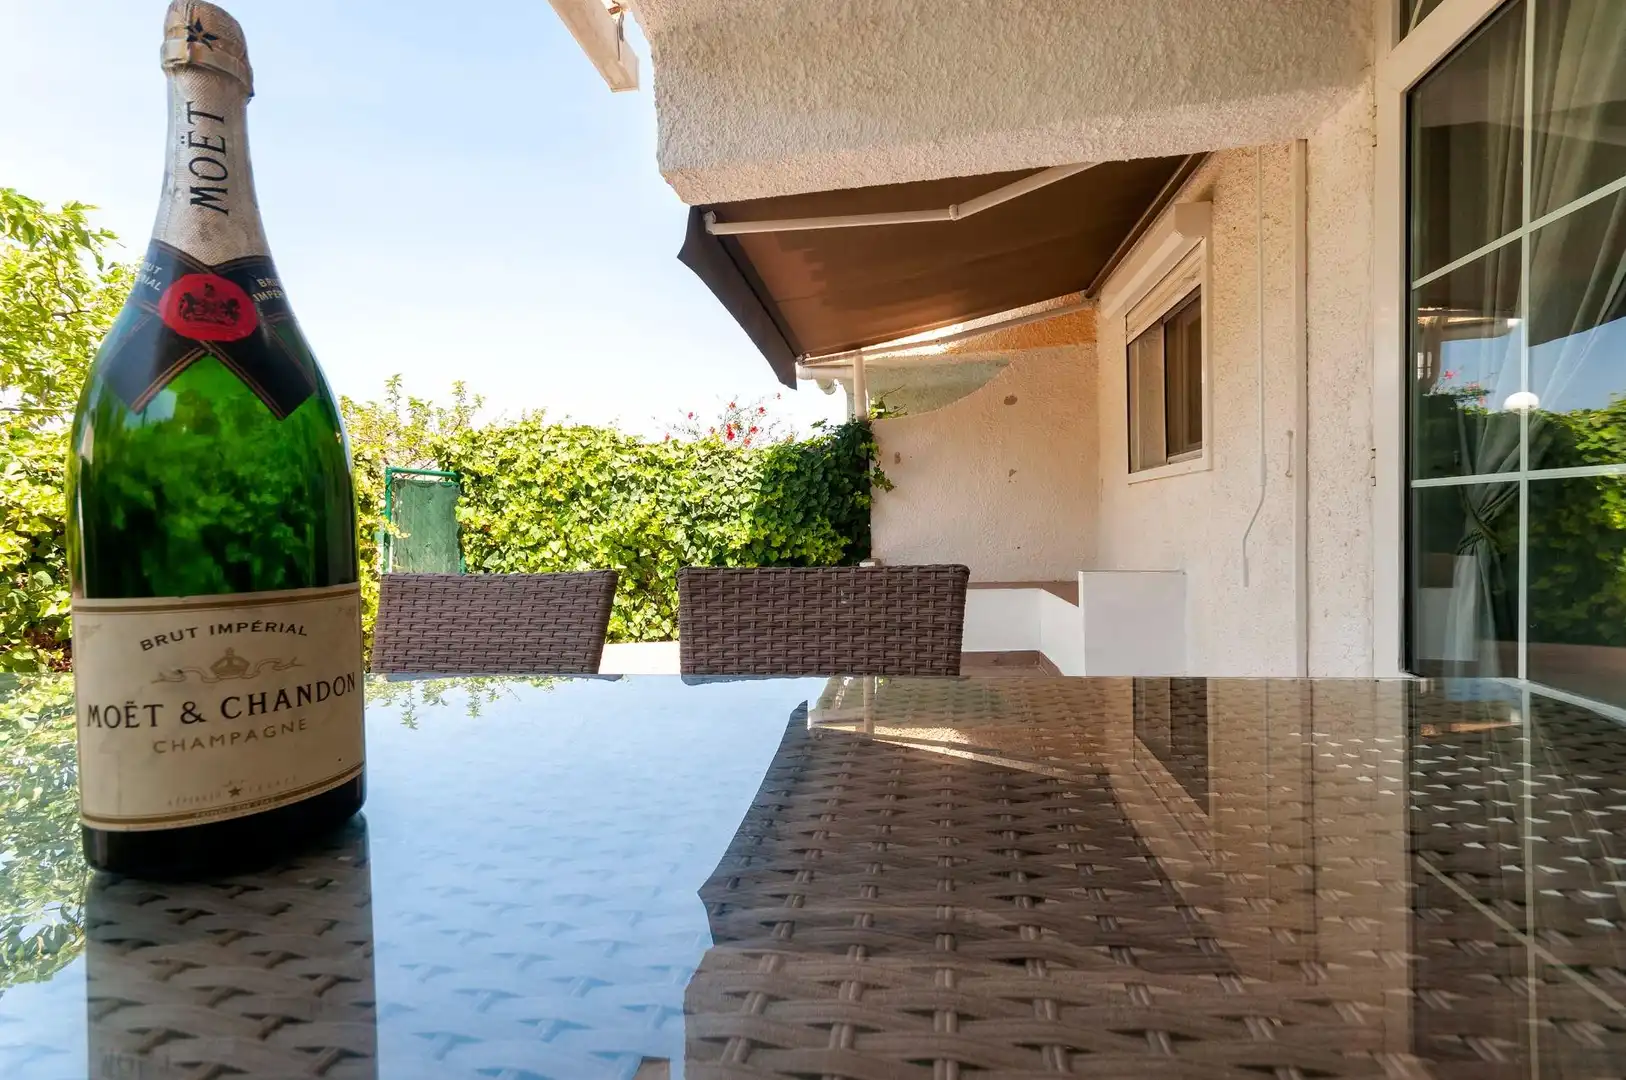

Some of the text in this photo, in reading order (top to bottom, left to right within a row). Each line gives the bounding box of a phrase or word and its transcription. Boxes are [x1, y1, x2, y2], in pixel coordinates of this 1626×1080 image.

[180, 100, 229, 217] MOËT
[139, 619, 309, 652] BRUT IMPÉRIAL
[87, 671, 357, 729] MOËT & CHANDON
[152, 718, 309, 754] CHAMPAGNE
